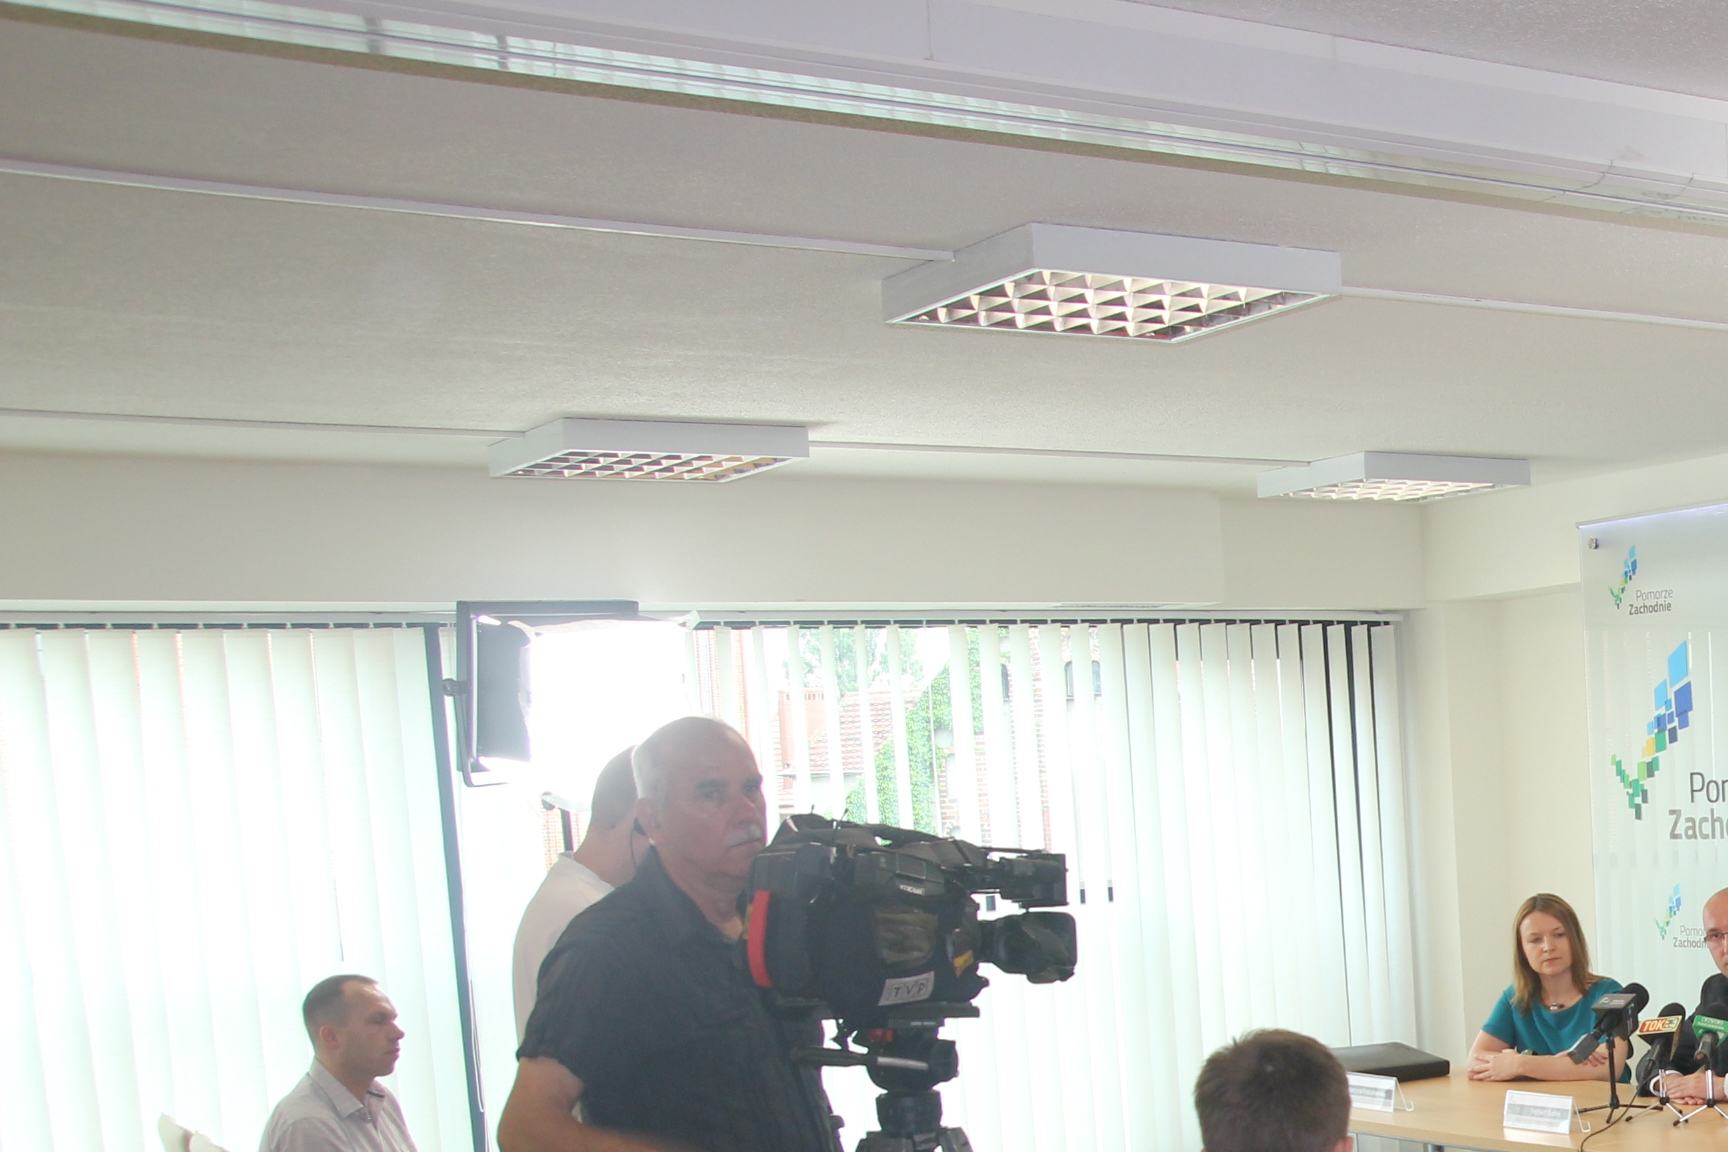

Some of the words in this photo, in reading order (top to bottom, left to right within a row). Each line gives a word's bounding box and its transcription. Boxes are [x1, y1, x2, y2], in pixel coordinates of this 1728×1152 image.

[1635, 587, 1673, 602] Pomorze
[1628, 600, 1672, 616] Zachodnie
[894, 982, 926, 998] TVP
[1643, 1019, 1665, 1032] TOK
